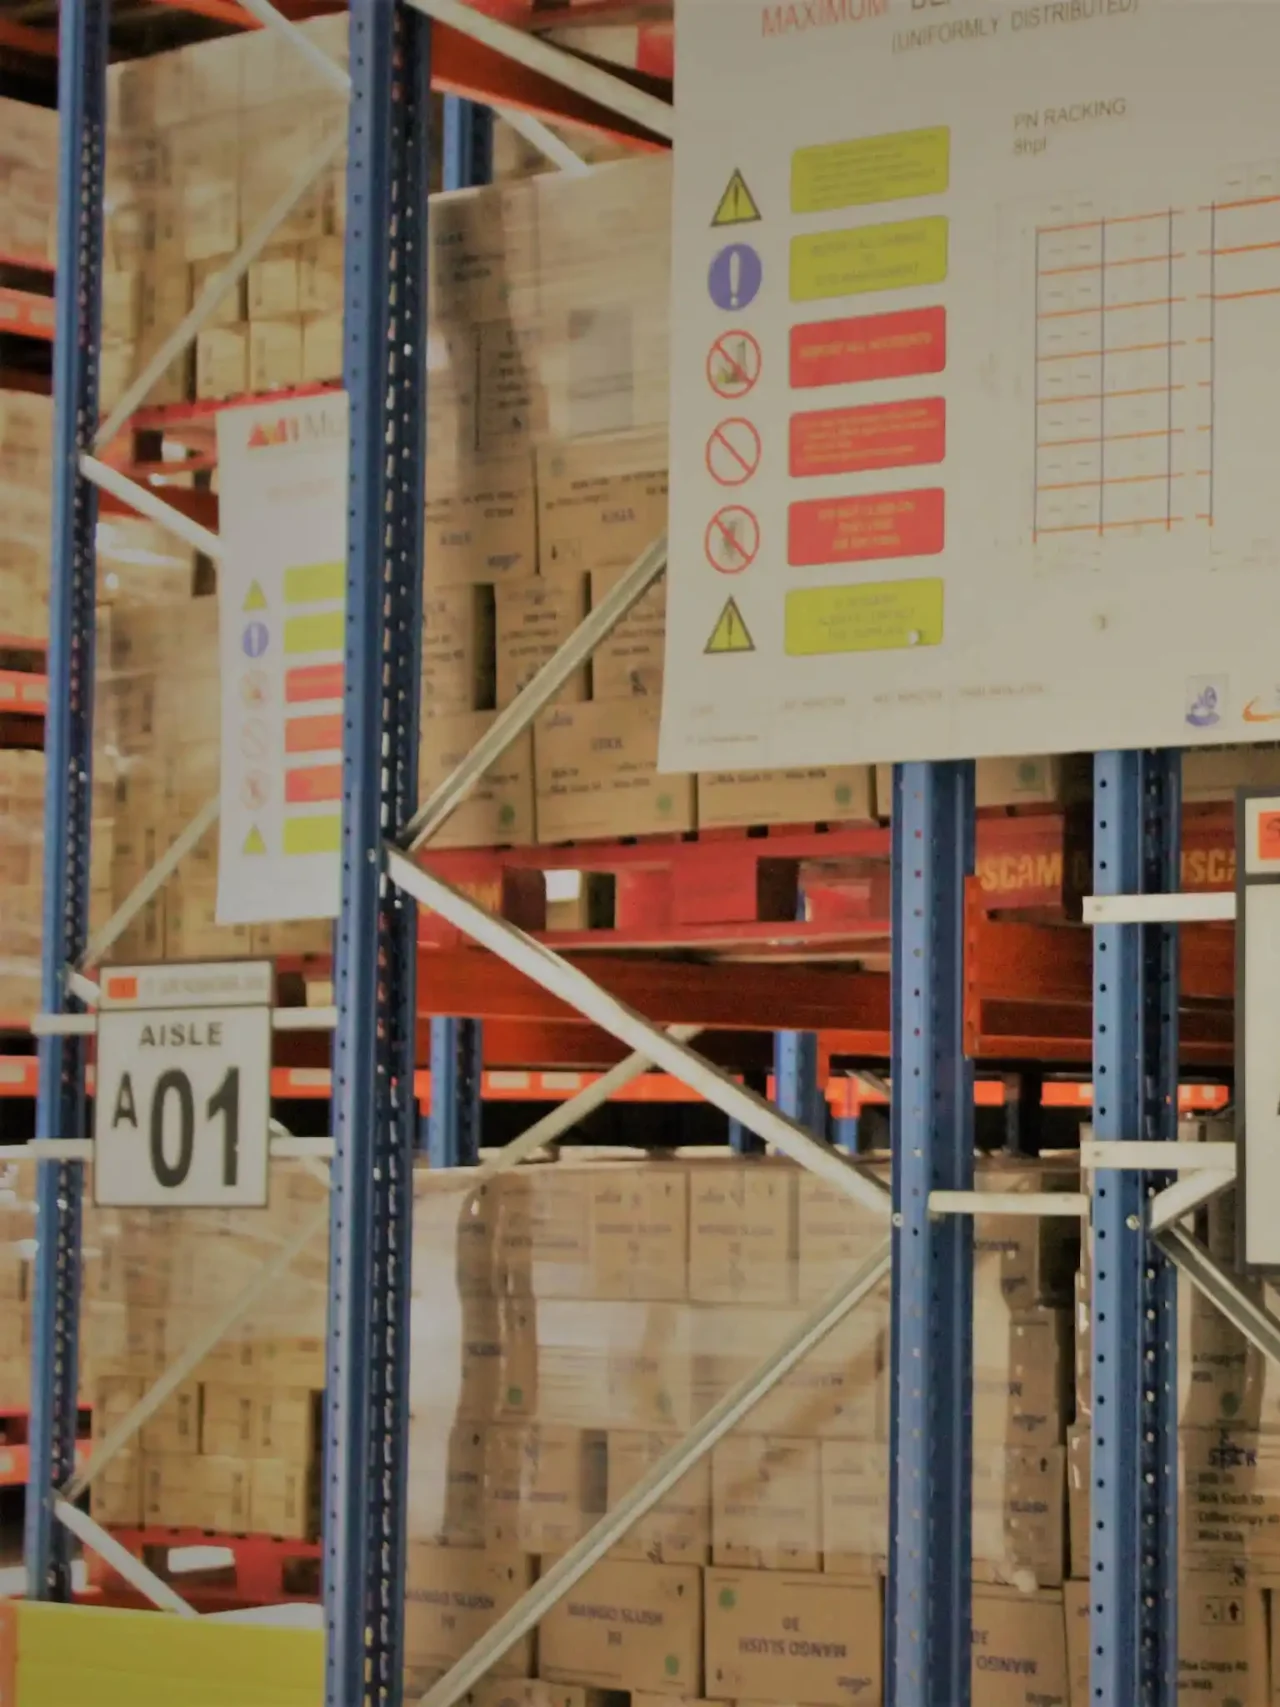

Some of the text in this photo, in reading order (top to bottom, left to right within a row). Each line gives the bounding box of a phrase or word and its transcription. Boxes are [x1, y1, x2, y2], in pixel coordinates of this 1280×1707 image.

[1043, 97, 1127, 126] RACKING
[980, 853, 1062, 891] SCAM
[139, 1021, 223, 1048] AISLE
[737, 1637, 848, 1659] MANGO SLUSH
